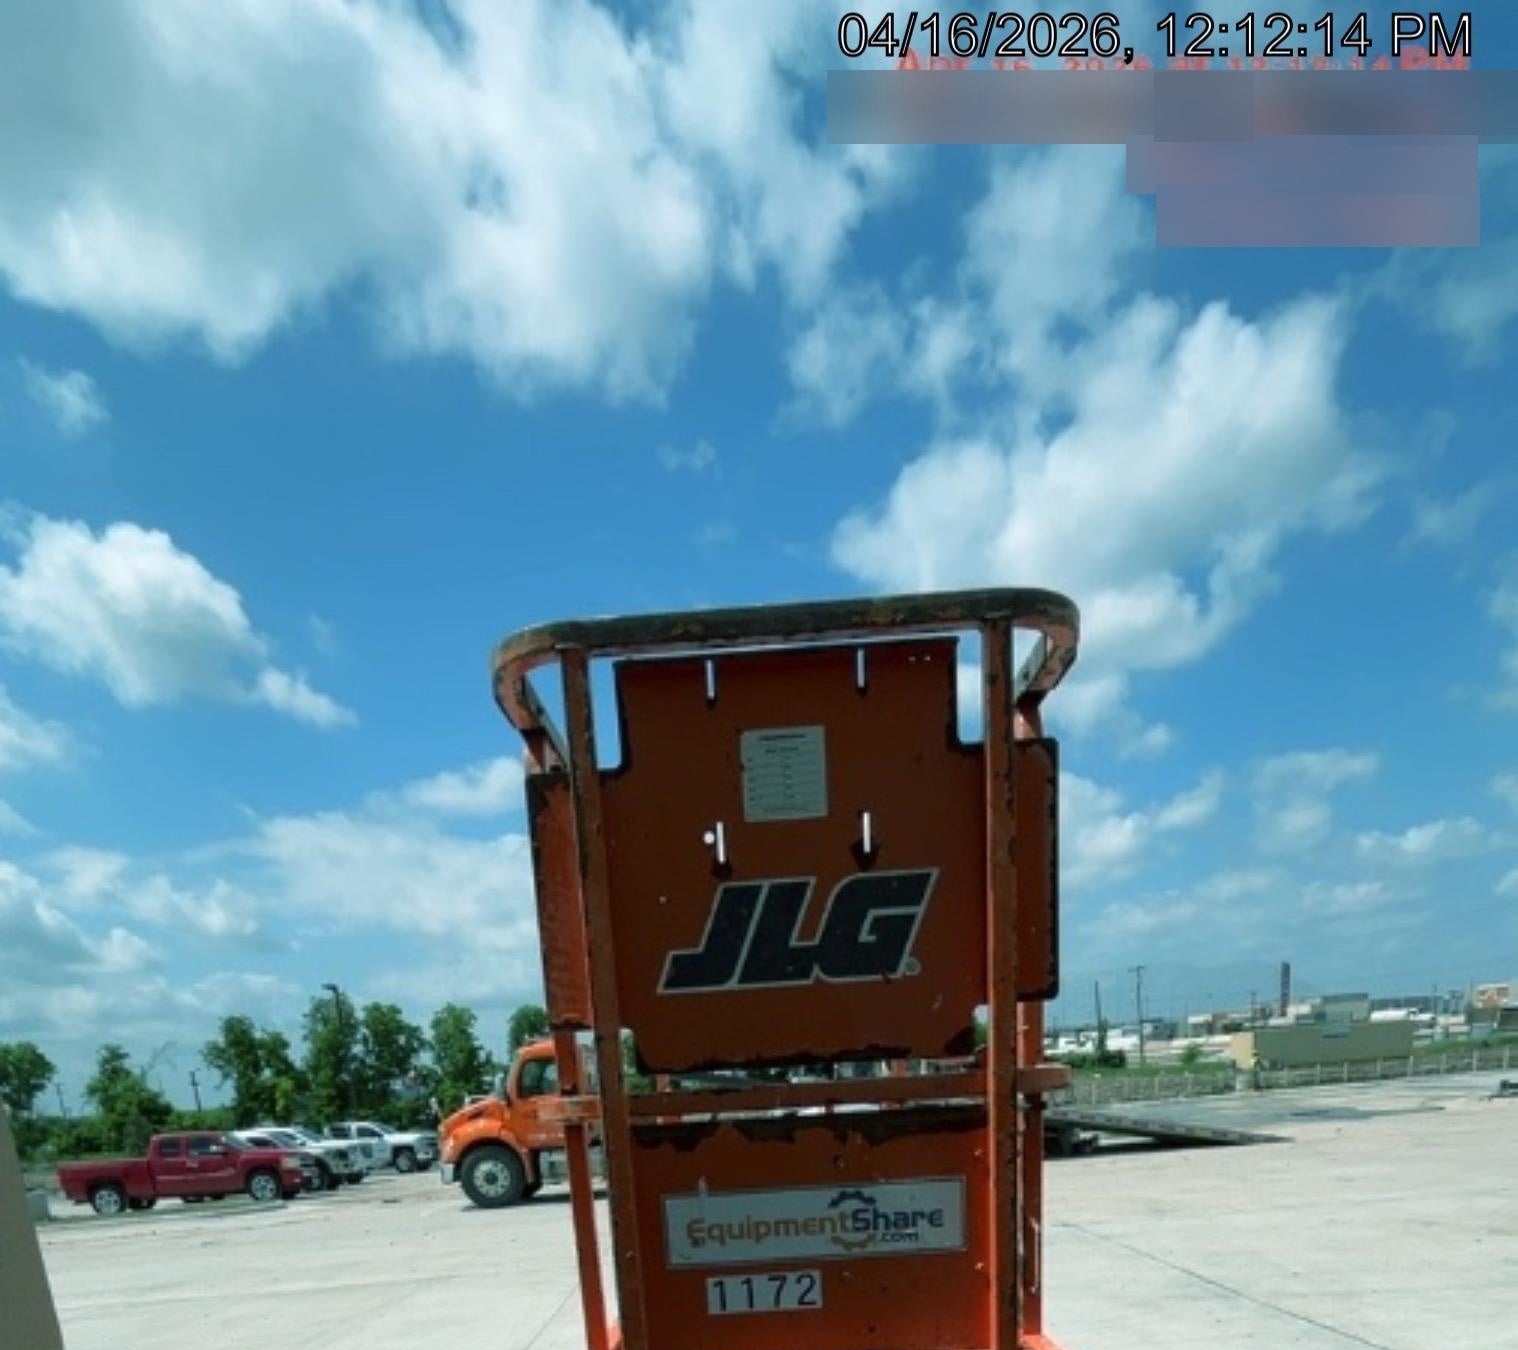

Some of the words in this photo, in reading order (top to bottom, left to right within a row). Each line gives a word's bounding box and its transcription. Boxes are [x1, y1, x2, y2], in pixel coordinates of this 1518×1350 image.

[657, 867, 940, 994] JLG
[686, 1207, 944, 1247] EquipmentShare
[713, 1272, 818, 1312] 1172
